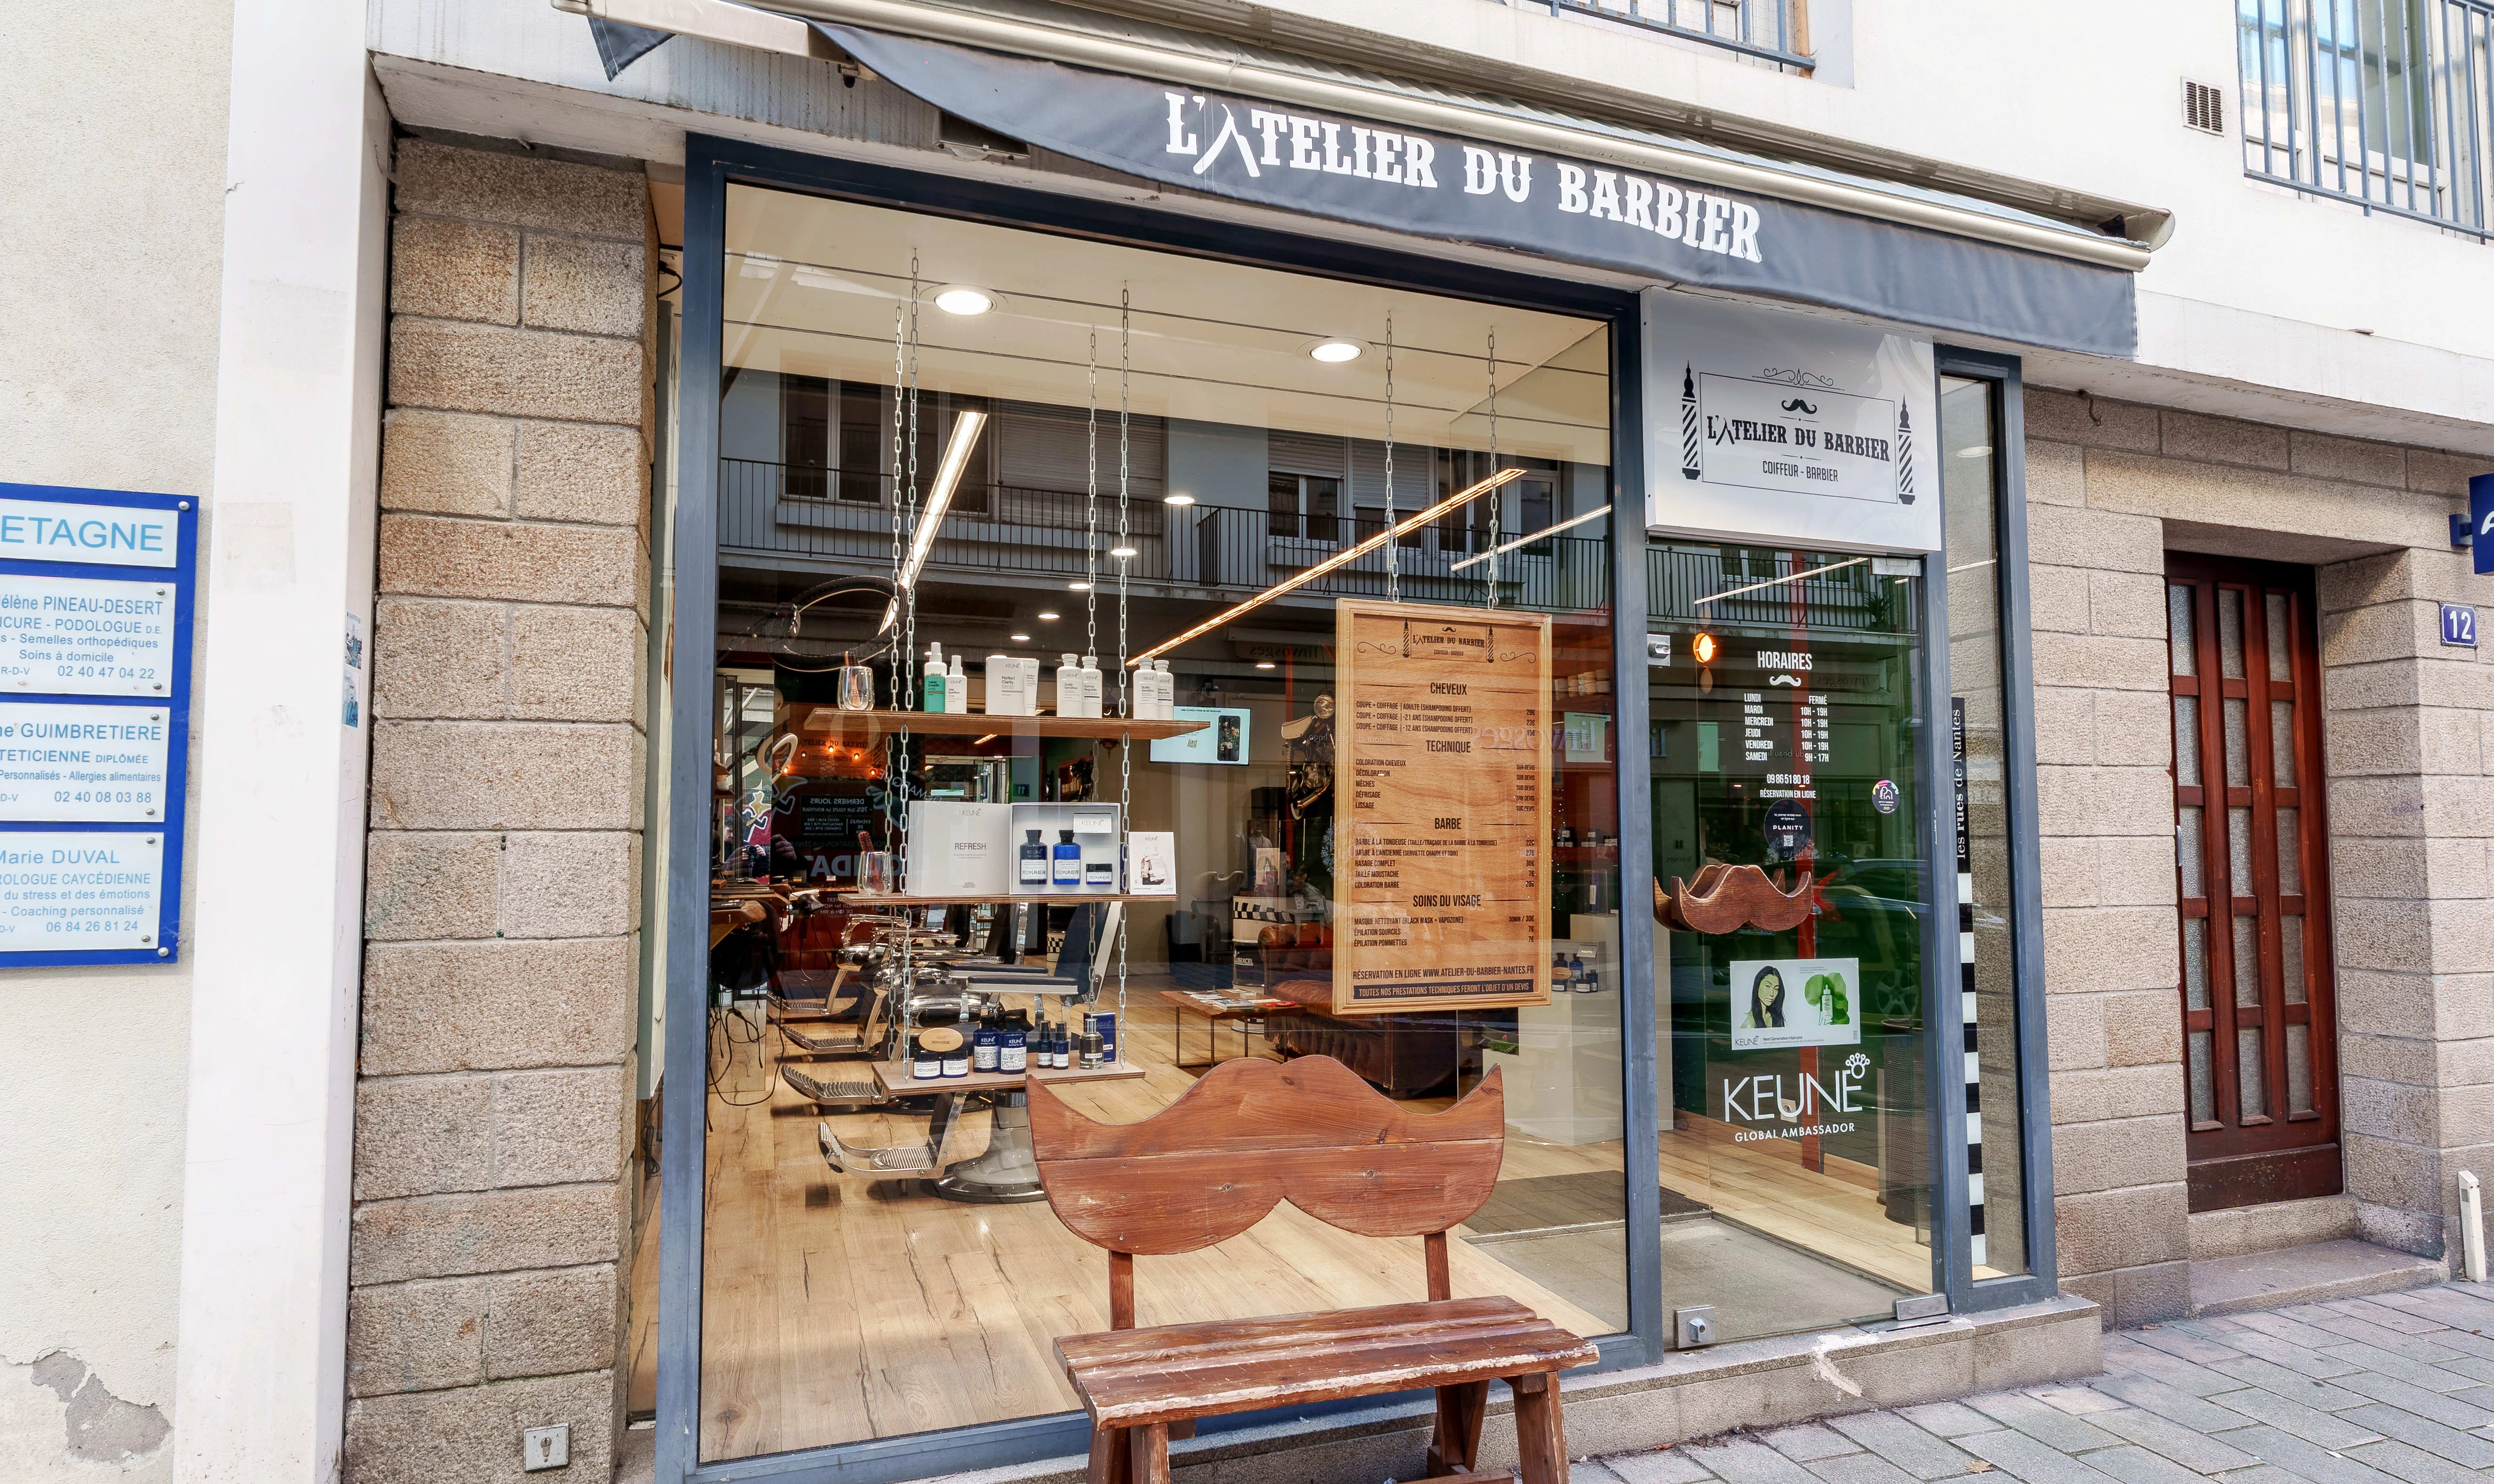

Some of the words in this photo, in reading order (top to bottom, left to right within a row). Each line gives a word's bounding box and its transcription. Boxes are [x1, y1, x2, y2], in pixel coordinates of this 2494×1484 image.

[1165, 91, 1440, 188] L'ATELIER
[1463, 145, 1534, 202] DU
[1557, 161, 1764, 263] BARBIER
[1707, 415, 1787, 445] L'ATELIER
[1795, 428, 1816, 447] DU
[1824, 432, 1890, 461] BARBIER
[1763, 461, 1798, 477] COIFFEUR
[1806, 467, 1838, 482] BARBIER
[1, 516, 163, 551] ETAGNE
[44, 596, 163, 615] PINEAU-DESERT
[56, 619, 141, 633] PODOLOGUE
[2449, 610, 2472, 640] 12
[20, 634, 72, 644] Semelles
[77, 636, 158, 649] orthopédiques
[1459, 638, 1485, 648] BARBIER
[19, 650, 51, 660] Soins
[56, 651, 62, 660] à
[67, 651, 113, 662] domicile
[1758, 651, 1812, 670] HORAIRES
[58, 666, 73, 676] 02
[78, 667, 94, 677] 40
[98, 667, 114, 677] 47
[119, 668, 134, 678] 04
[139, 668, 154, 679] 22
[1430, 682, 1467, 695] CHEVEUX
[1744, 693, 1761, 702] LUNDI
[1809, 695, 1827, 705] FERMÉ
[1745, 705, 1763, 714] MARDI
[1801, 707, 1811, 715] 10H
[1817, 707, 1827, 716] 19H
[1745, 716, 1773, 726] MERCREDI
[1801, 718, 1811, 727] 10H
[1817, 719, 1827, 728] 19H
[21, 723, 161, 740] GUIMBRETIERE
[1745, 728, 1760, 737] JEUDI
[1801, 730, 1812, 738] 10H
[1818, 730, 1828, 739] 19H
[1952, 708, 1962, 762] Nantes
[1426, 740, 1470, 754] TECHNIQUE
[1745, 740, 1773, 749] VENDREDI
[1802, 741, 1812, 750] 10H
[1818, 742, 1828, 750] 19H
[96, 754, 148, 763] DIPLÔMÉE
[1746, 752, 1767, 761] SAMEDI
[1805, 753, 1812, 762] 9H
[1818, 754, 1829, 762] 17H
[69, 771, 106, 783] Allergies
[110, 772, 160, 781] alimentaires
[1767, 774, 1775, 784] 09
[1776, 774, 1784, 784] 86
[1785, 774, 1792, 784] 51
[1793, 775, 1801, 784] 80
[1802, 775, 1810, 784] 18
[1955, 768, 1963, 787] de
[55, 792, 70, 802] 02
[75, 792, 90, 802] 40
[96, 792, 111, 802] 08
[116, 792, 131, 802] 03
[137, 793, 151, 802] 88
[1760, 788, 1793, 798] RÉSERVATION
[1435, 818, 1461, 829] BARBE
[1957, 837, 1966, 859] les
[52, 850, 119, 864] DUVAL
[62, 871, 151, 884] CAYCÉDIENNE
[5, 890, 18, 899] du
[23, 891, 56, 899] stress
[61, 890, 71, 899] et
[75, 890, 95, 899] des
[100, 889, 150, 898] émotions
[1413, 895, 1437, 907] SOINS
[1440, 895, 1450, 906] DU
[1453, 895, 1481, 906] VISAGE
[11, 906, 67, 918] Coaching
[71, 905, 143, 918] personnalisé
[47, 922, 61, 932] 06
[66, 922, 80, 932] 84
[85, 921, 100, 931] 26
[105, 921, 118, 931] 81
[124, 921, 137, 930] 24
[1353, 969, 1393, 979] RÉSERVATION
[1405, 969, 1421, 978] LIGNE
[1735, 1036, 1759, 1046] KEUNE
[1724, 1070, 1863, 1123] KEUNE
[1735, 1129, 1778, 1142] GLOBAL
[1781, 1122, 1855, 1138] AMBASSADOR
